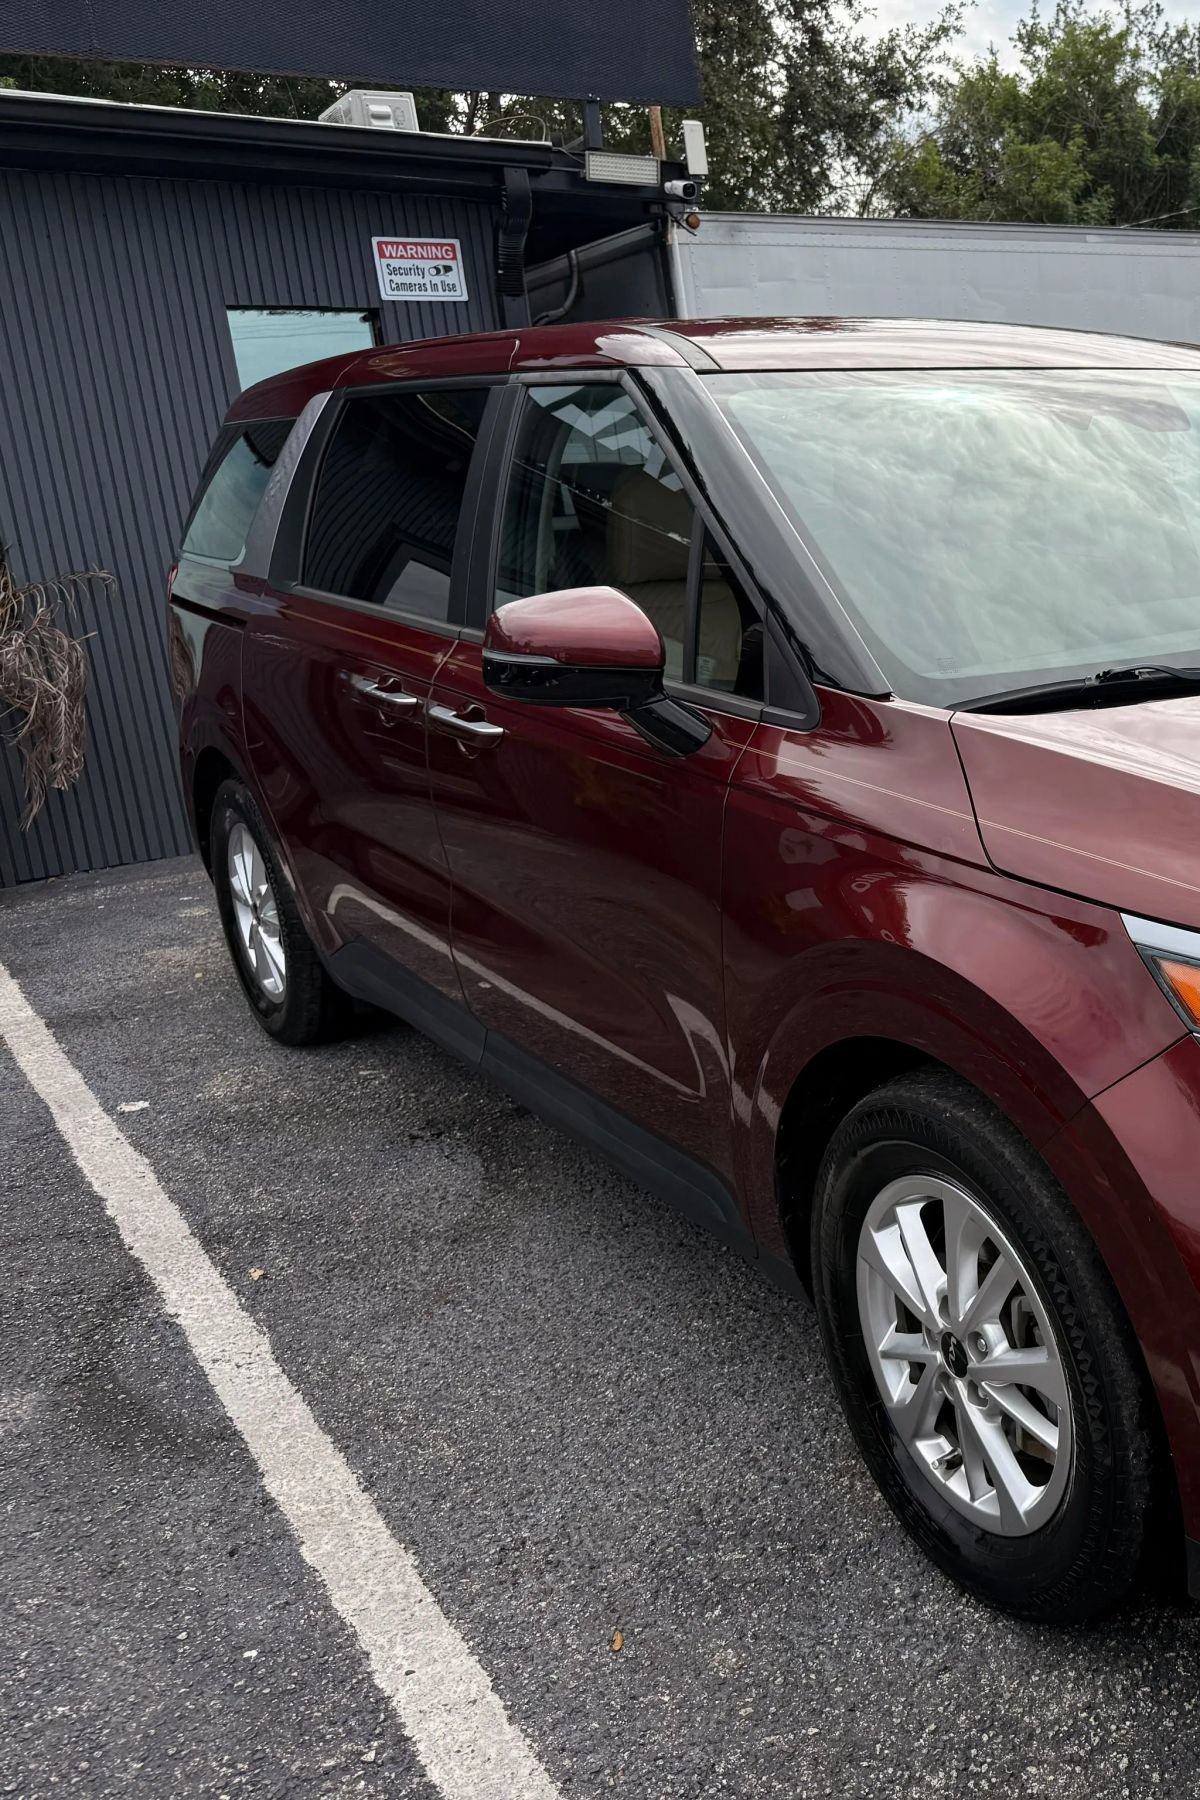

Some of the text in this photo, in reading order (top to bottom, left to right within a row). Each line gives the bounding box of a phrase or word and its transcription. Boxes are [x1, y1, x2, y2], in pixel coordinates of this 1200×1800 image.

[382, 244, 453, 259] WARNING
[386, 263, 425, 279] Security
[389, 279, 457, 292] Cameras In Use
